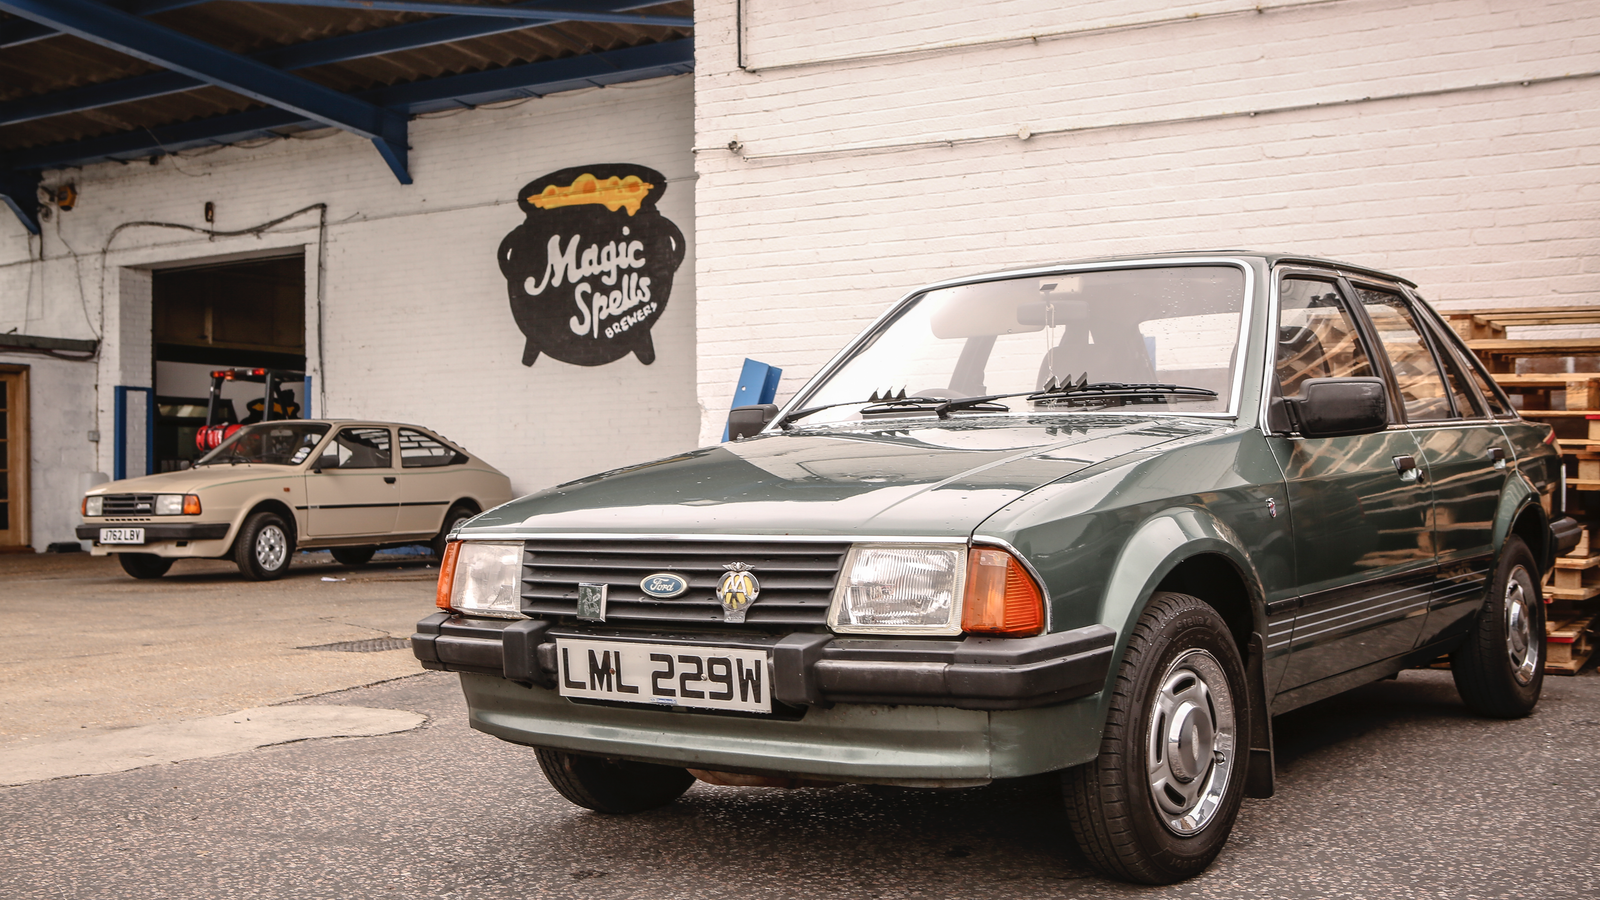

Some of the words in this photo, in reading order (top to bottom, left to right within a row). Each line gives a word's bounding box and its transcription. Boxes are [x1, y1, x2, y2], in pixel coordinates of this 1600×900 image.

[524, 226, 646, 295] Magic
[570, 272, 651, 338] Spells
[605, 302, 658, 338] BREWERY
[103, 529, 122, 541] J762
[124, 529, 140, 541] LBV
[650, 577, 675, 591] Ford
[562, 647, 639, 694] LML
[650, 653, 761, 703] 229W
